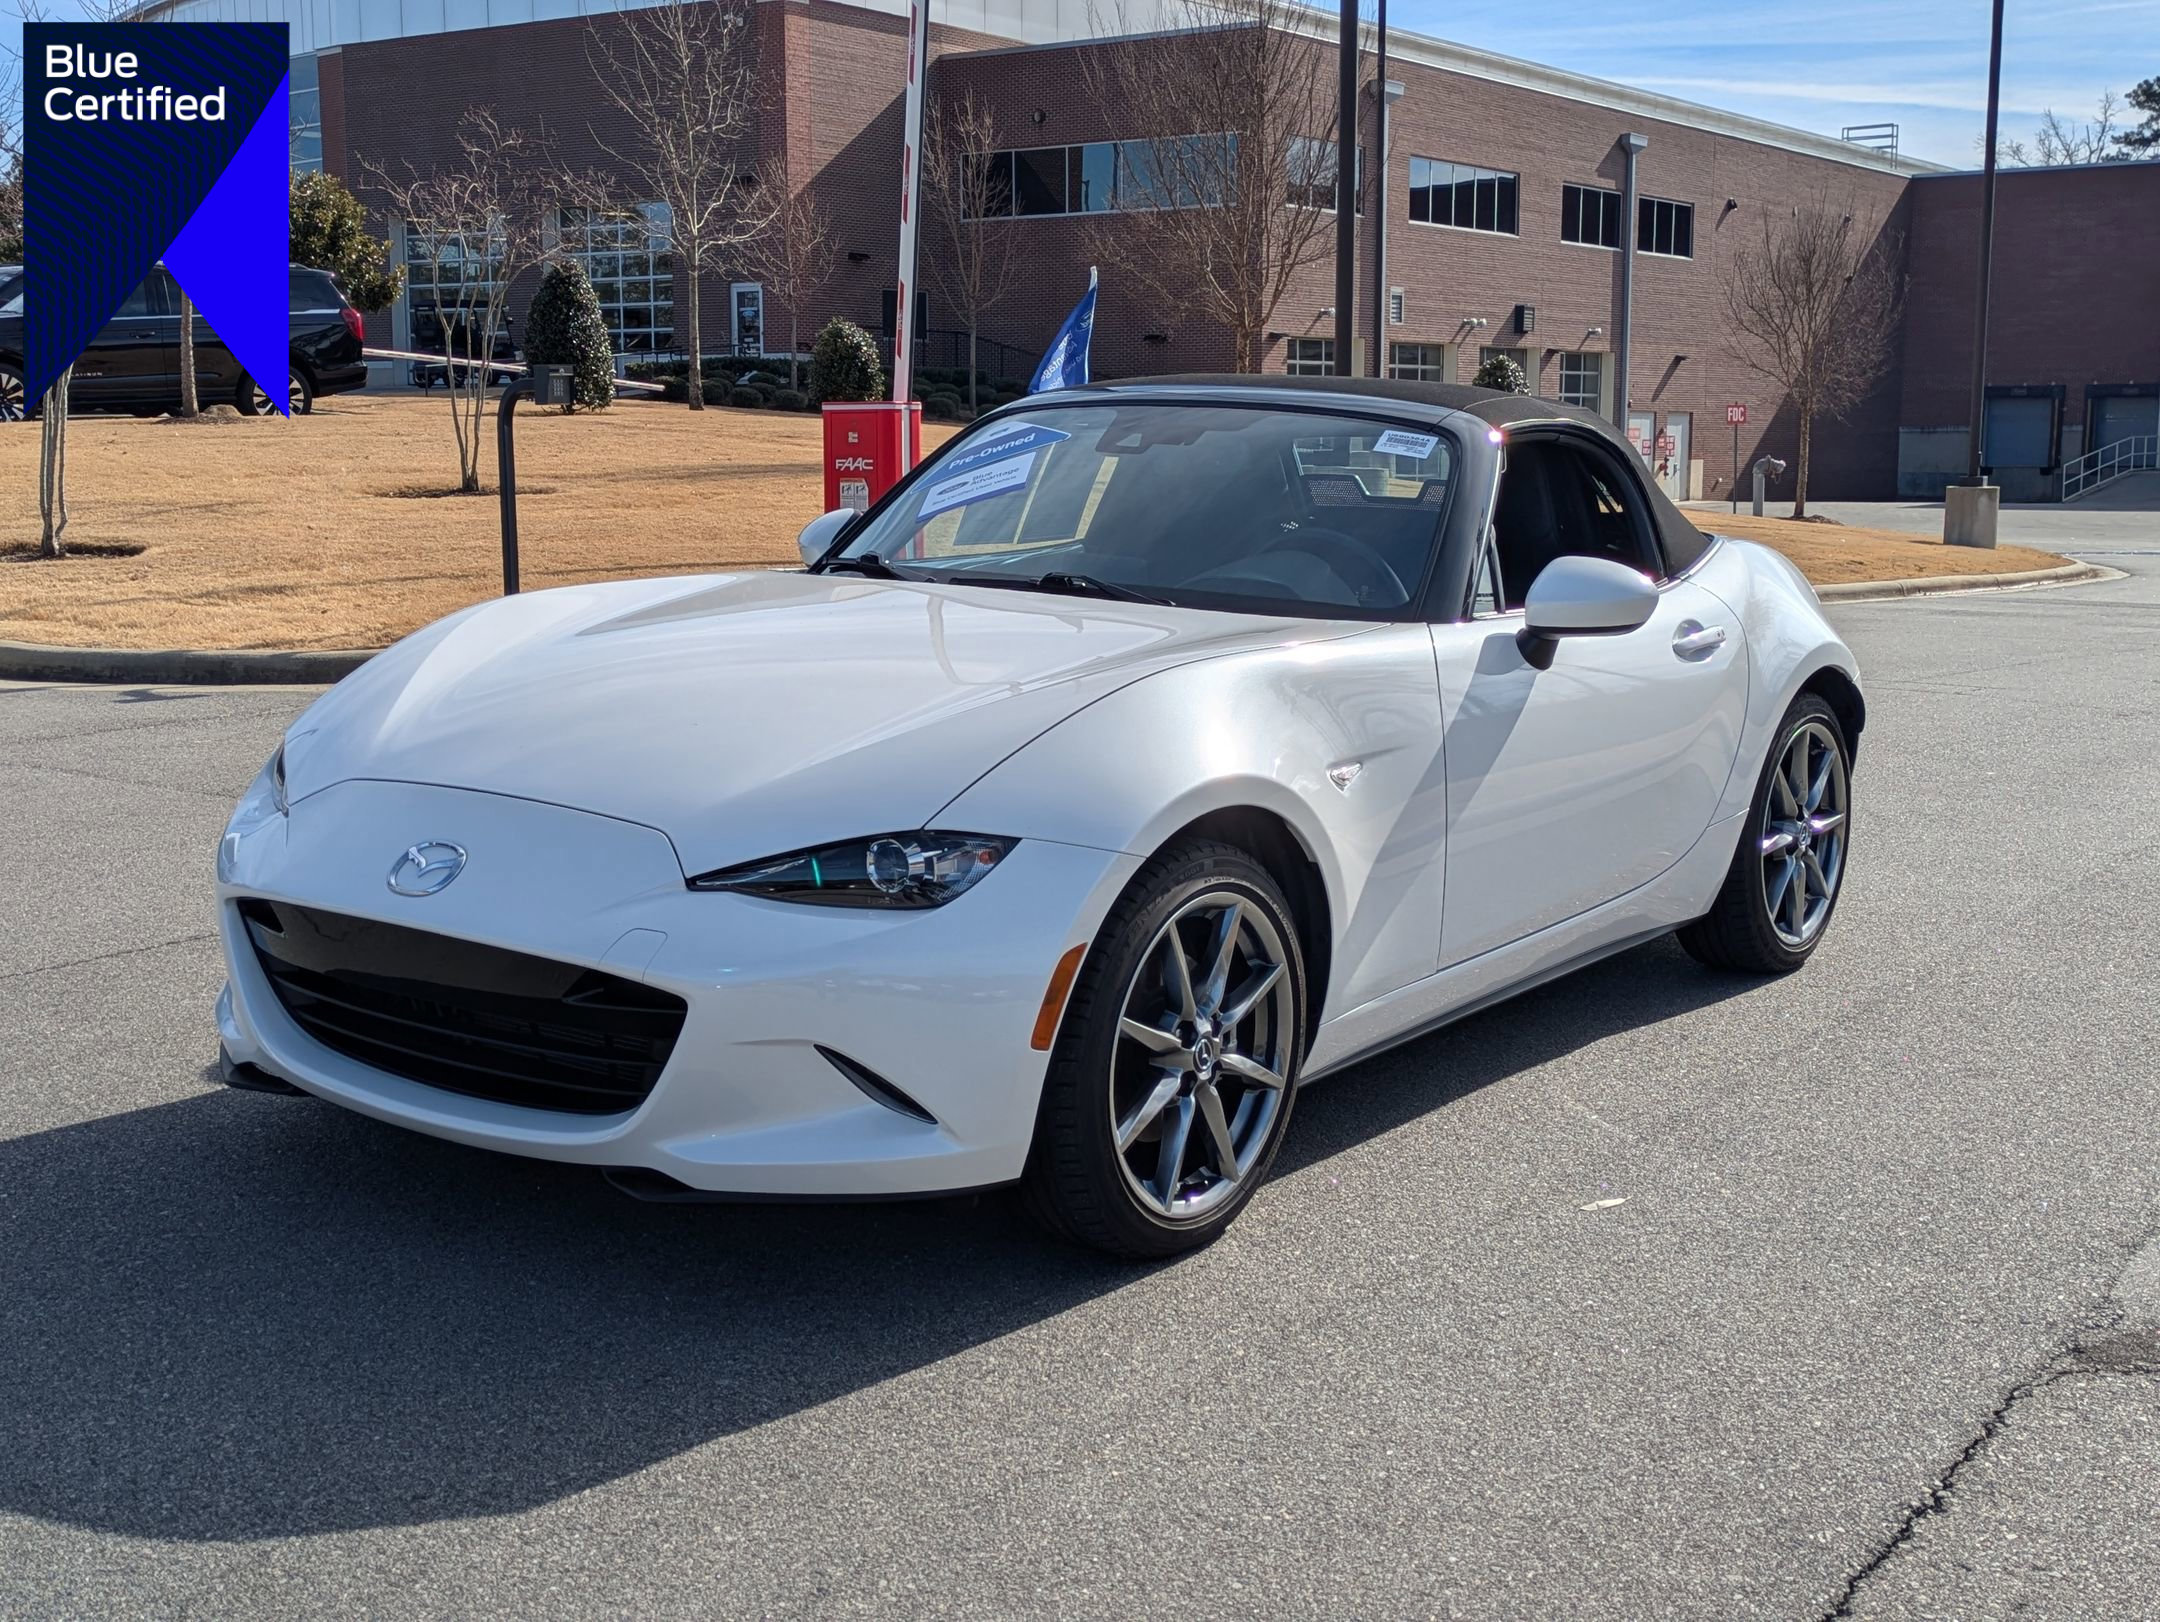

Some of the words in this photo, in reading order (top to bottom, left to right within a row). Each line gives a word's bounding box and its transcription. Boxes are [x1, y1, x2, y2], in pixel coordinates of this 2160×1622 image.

[1727, 407, 1745, 422] FDC
[948, 432, 1036, 470] Pre-Owned
[835, 456, 874, 472] FAAC
